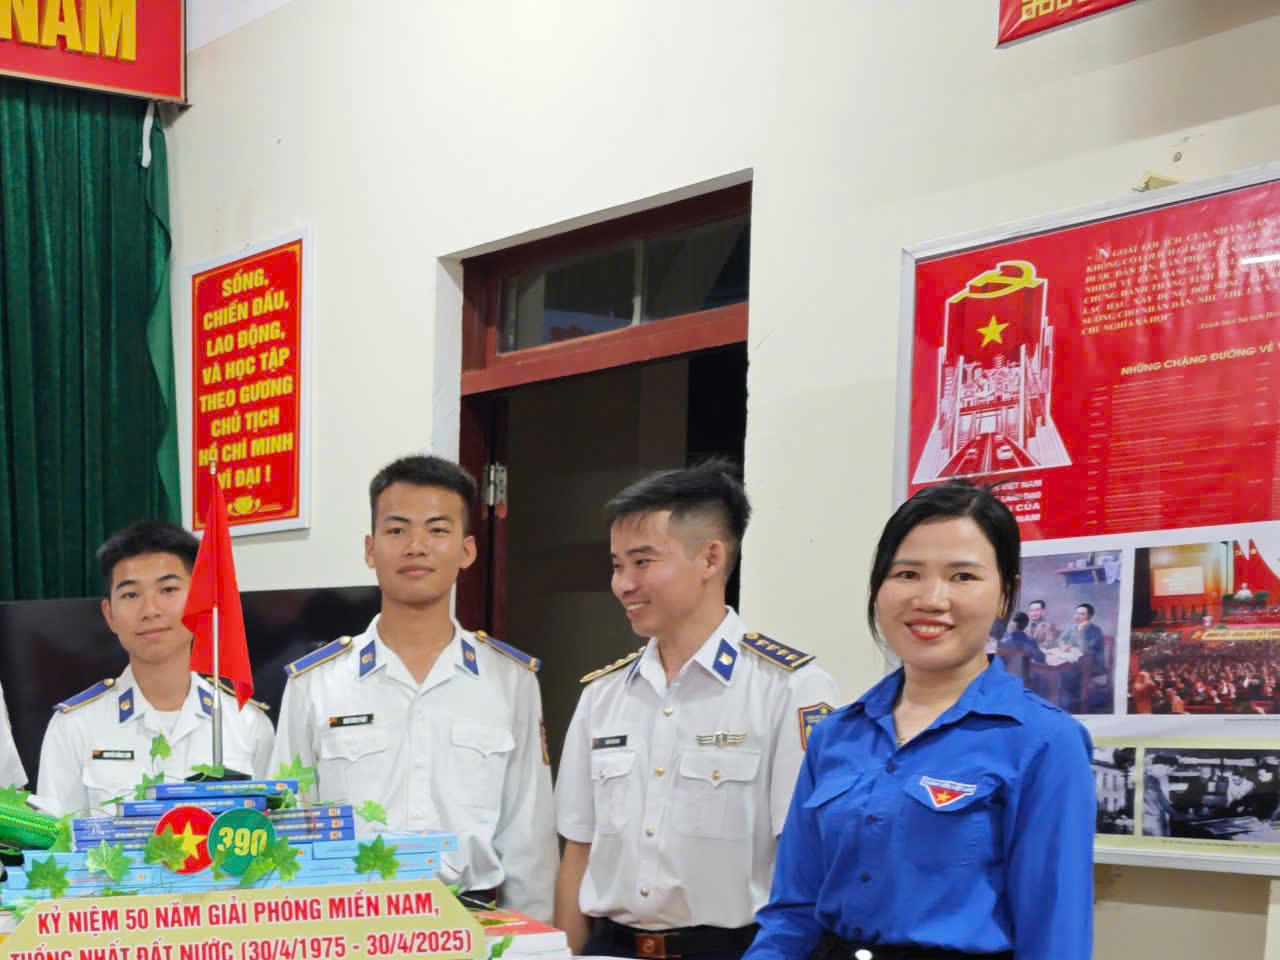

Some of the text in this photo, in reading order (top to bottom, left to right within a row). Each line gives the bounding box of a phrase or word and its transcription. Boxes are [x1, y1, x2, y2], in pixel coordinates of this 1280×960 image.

[206, 334, 235, 358] LAO
[202, 346, 290, 385] VÀ HỌC TẬP
[199, 389, 236, 413] THEO
[211, 406, 280, 437] CHỦ TỊCH
[222, 438, 247, 462] CHÍ
[251, 432, 293, 458] MINH
[235, 466, 261, 489] ĐẠI
[217, 826, 268, 857] 390
[37, 904, 62, 935] KỶ
[69, 906, 119, 937] NIỆM
[125, 907, 149, 930] 50
[155, 901, 201, 929] NĂM
[208, 896, 248, 925] GIẢI
[254, 896, 321, 923] PHÓNG
[386, 892, 439, 917] NAM,
[366, 929, 472, 956] 30/4/2025)
